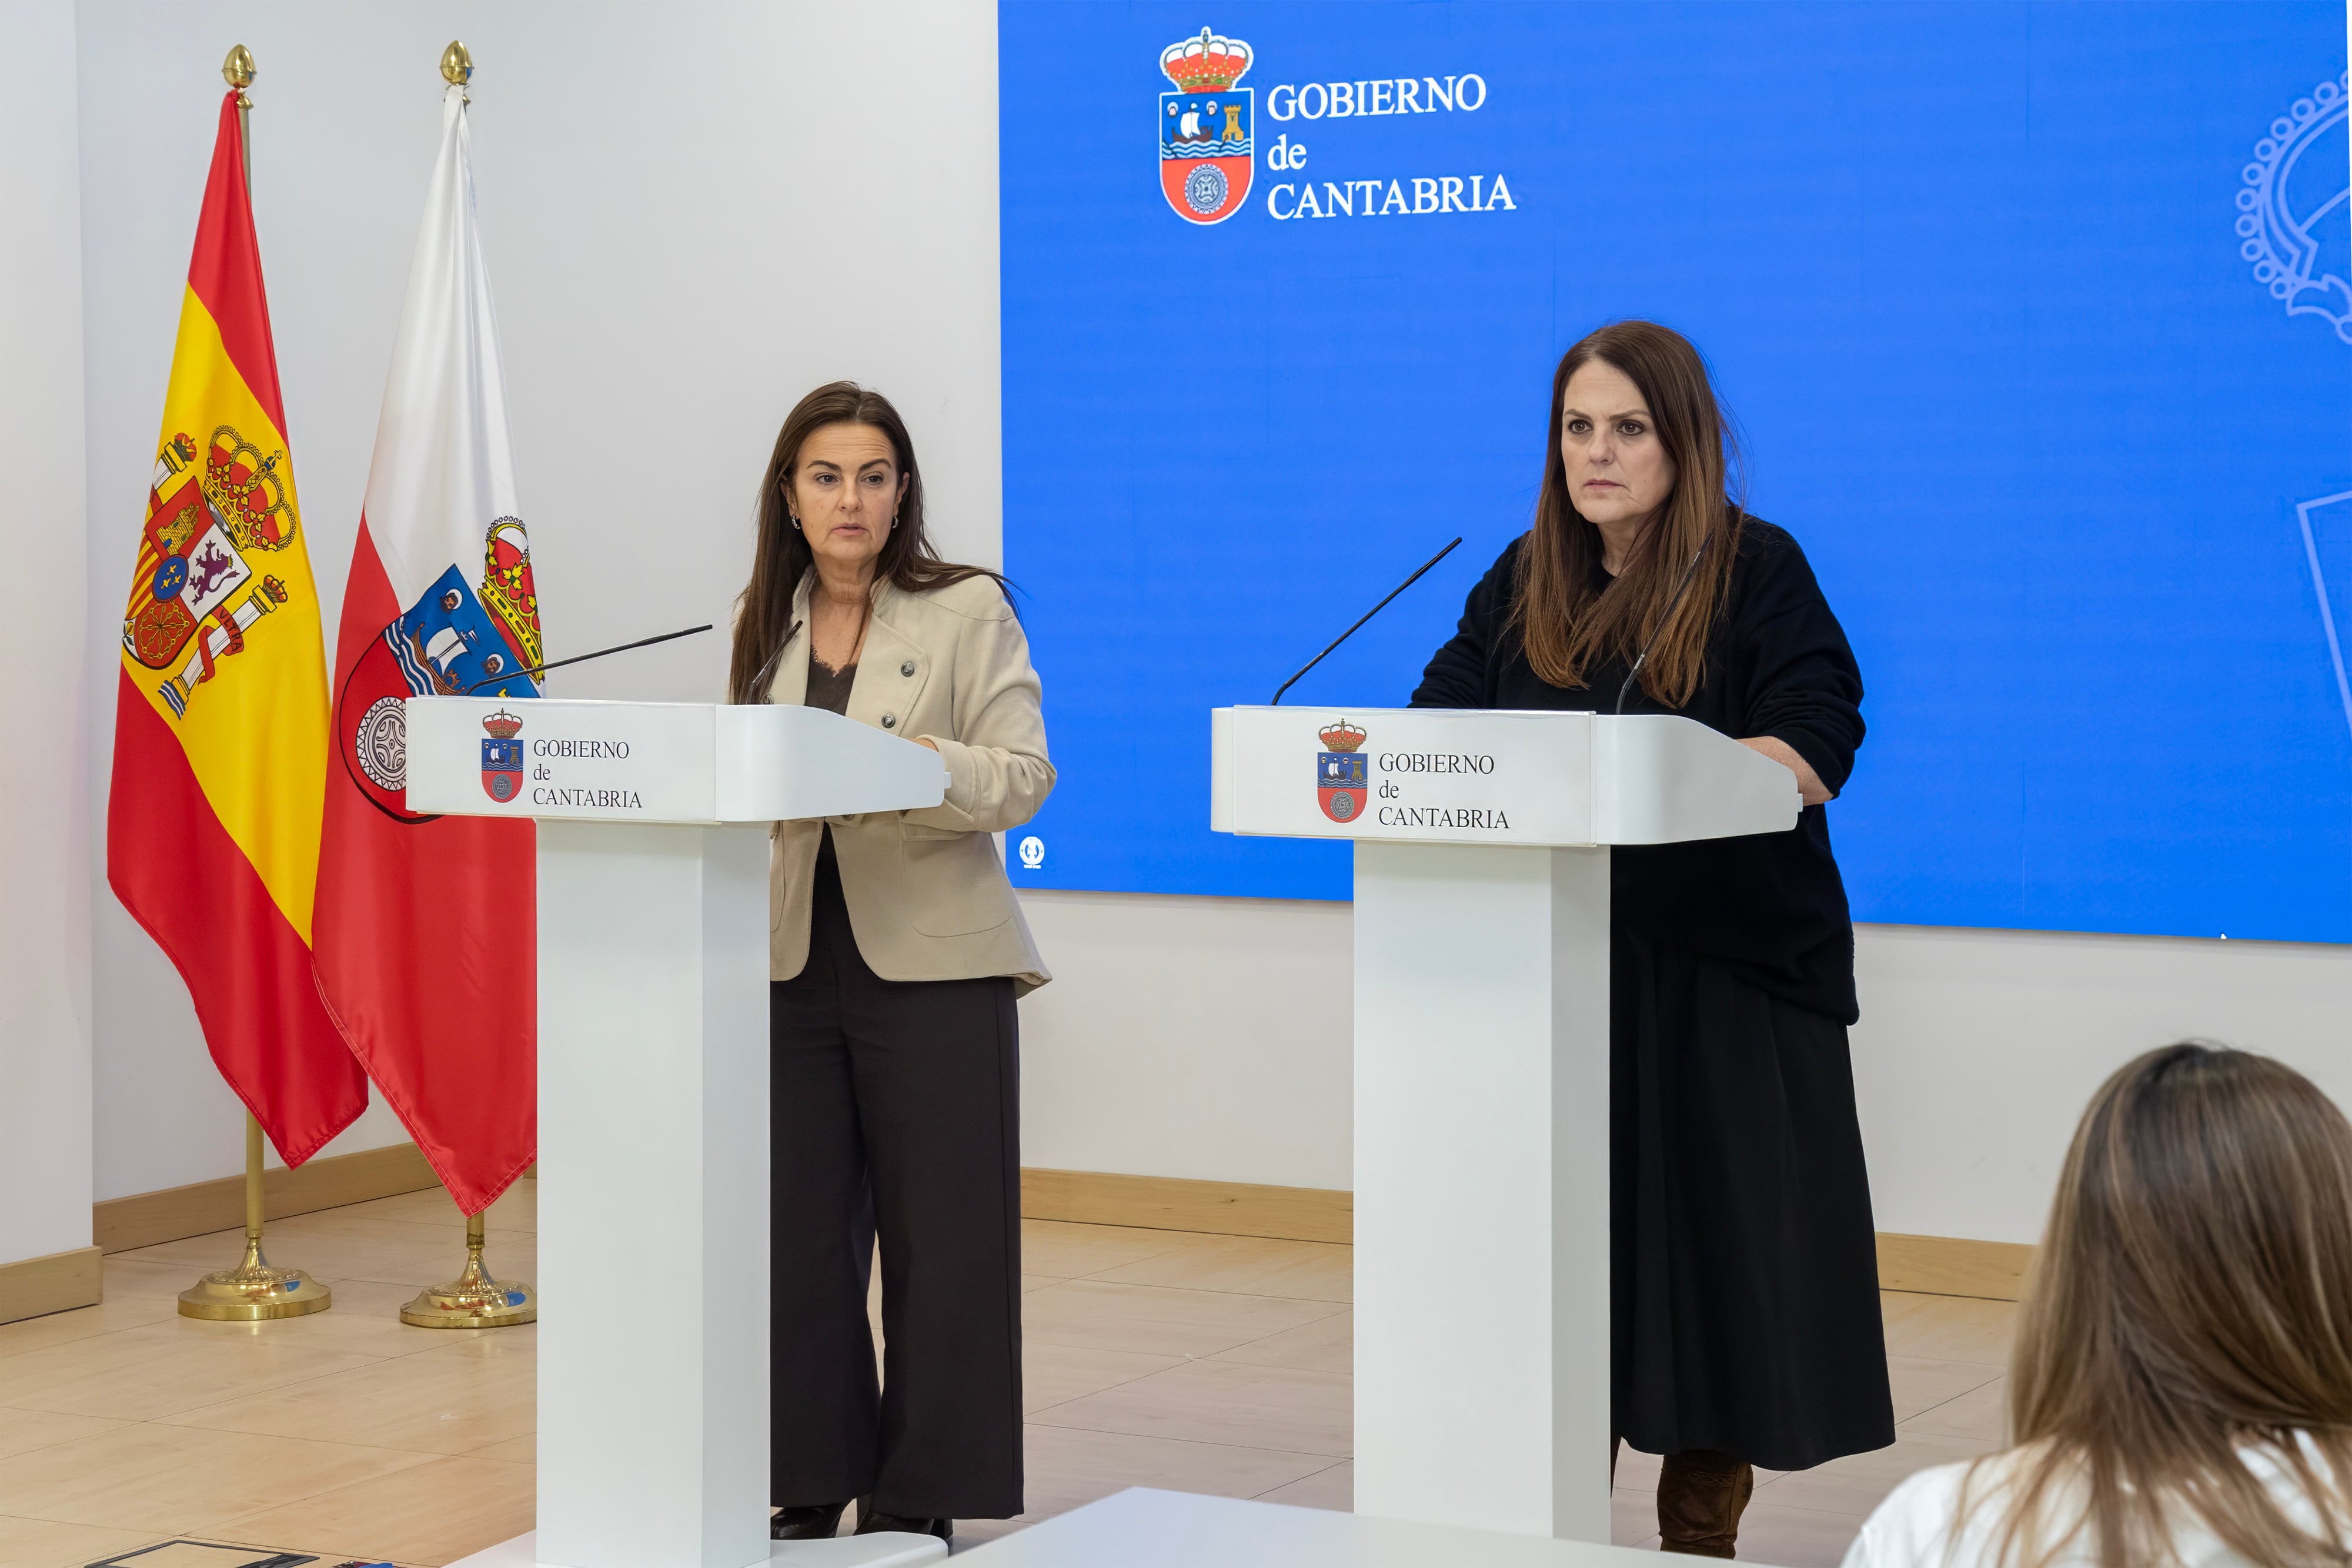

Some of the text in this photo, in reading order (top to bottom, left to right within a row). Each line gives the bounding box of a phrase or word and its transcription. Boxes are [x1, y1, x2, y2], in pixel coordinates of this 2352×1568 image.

[1267, 73, 1486, 121] GOBIERNO
[1267, 133, 1307, 171] de
[1267, 173, 1517, 220] CANTABRIA
[533, 739, 629, 759] GOBIERNO
[533, 763, 551, 781] de
[1379, 753, 1495, 775] GOBIERNO
[533, 787, 642, 808] CANTABRIA
[1379, 780, 1399, 799] de
[1378, 807, 1510, 829] CANTABRIA
